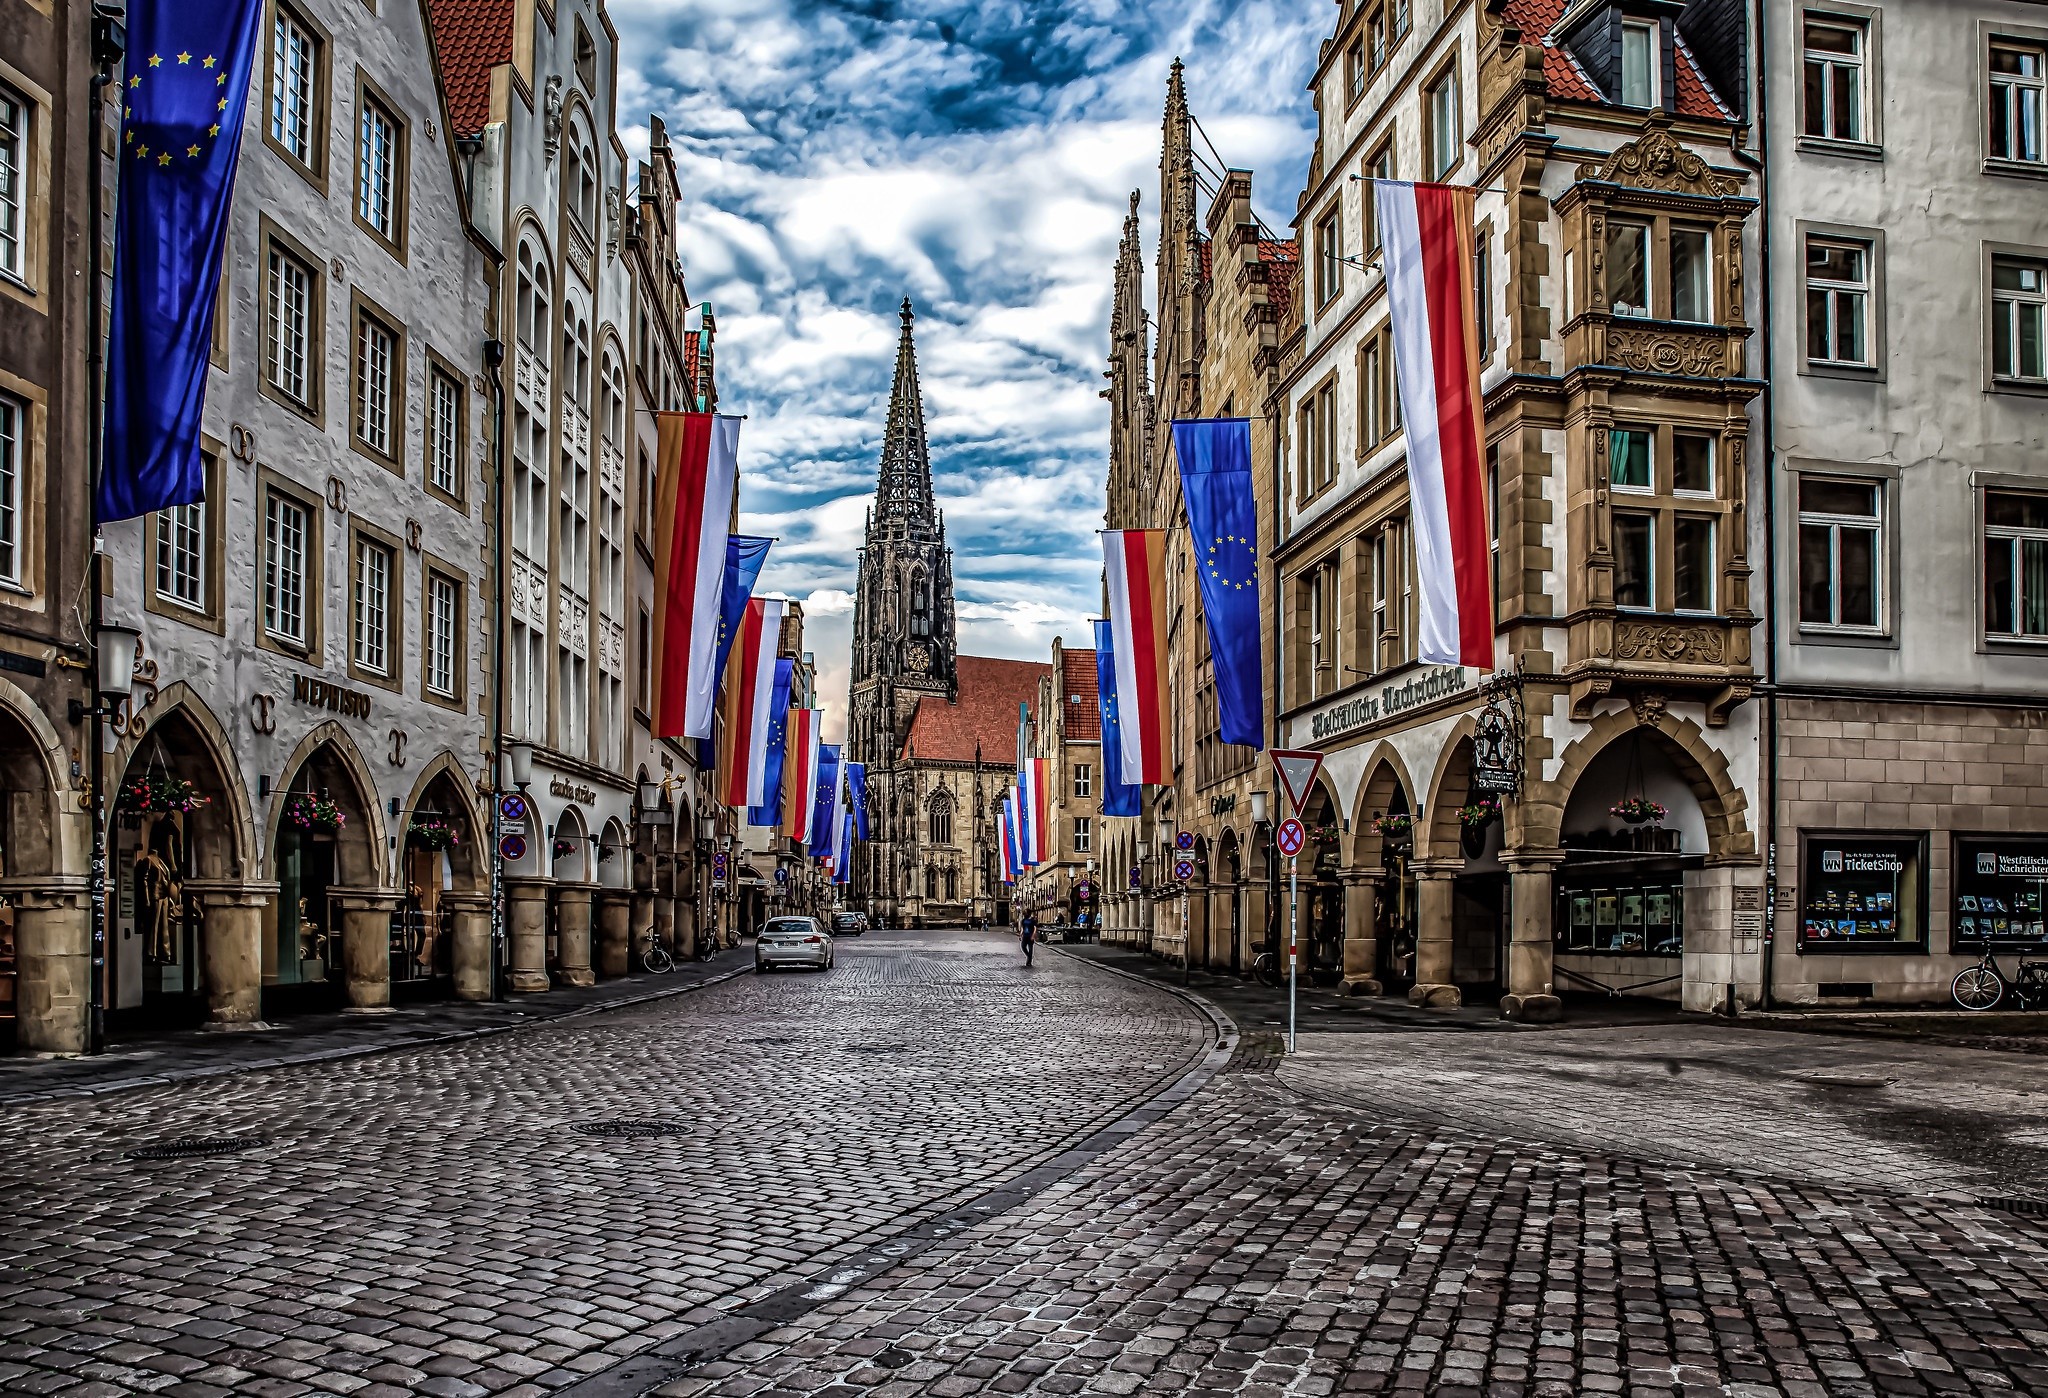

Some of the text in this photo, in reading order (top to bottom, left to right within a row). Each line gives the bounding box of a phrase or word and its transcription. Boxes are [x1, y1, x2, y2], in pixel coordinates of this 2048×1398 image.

[1658, 348, 1678, 361] 1898
[293, 673, 372, 720] MEPHISTO
[1382, 666, 1466, 714] Nachrichten
[1824, 859, 1840, 870] WN
[1845, 859, 1903, 873] TicketShop
[1978, 861, 1994, 872] WN
